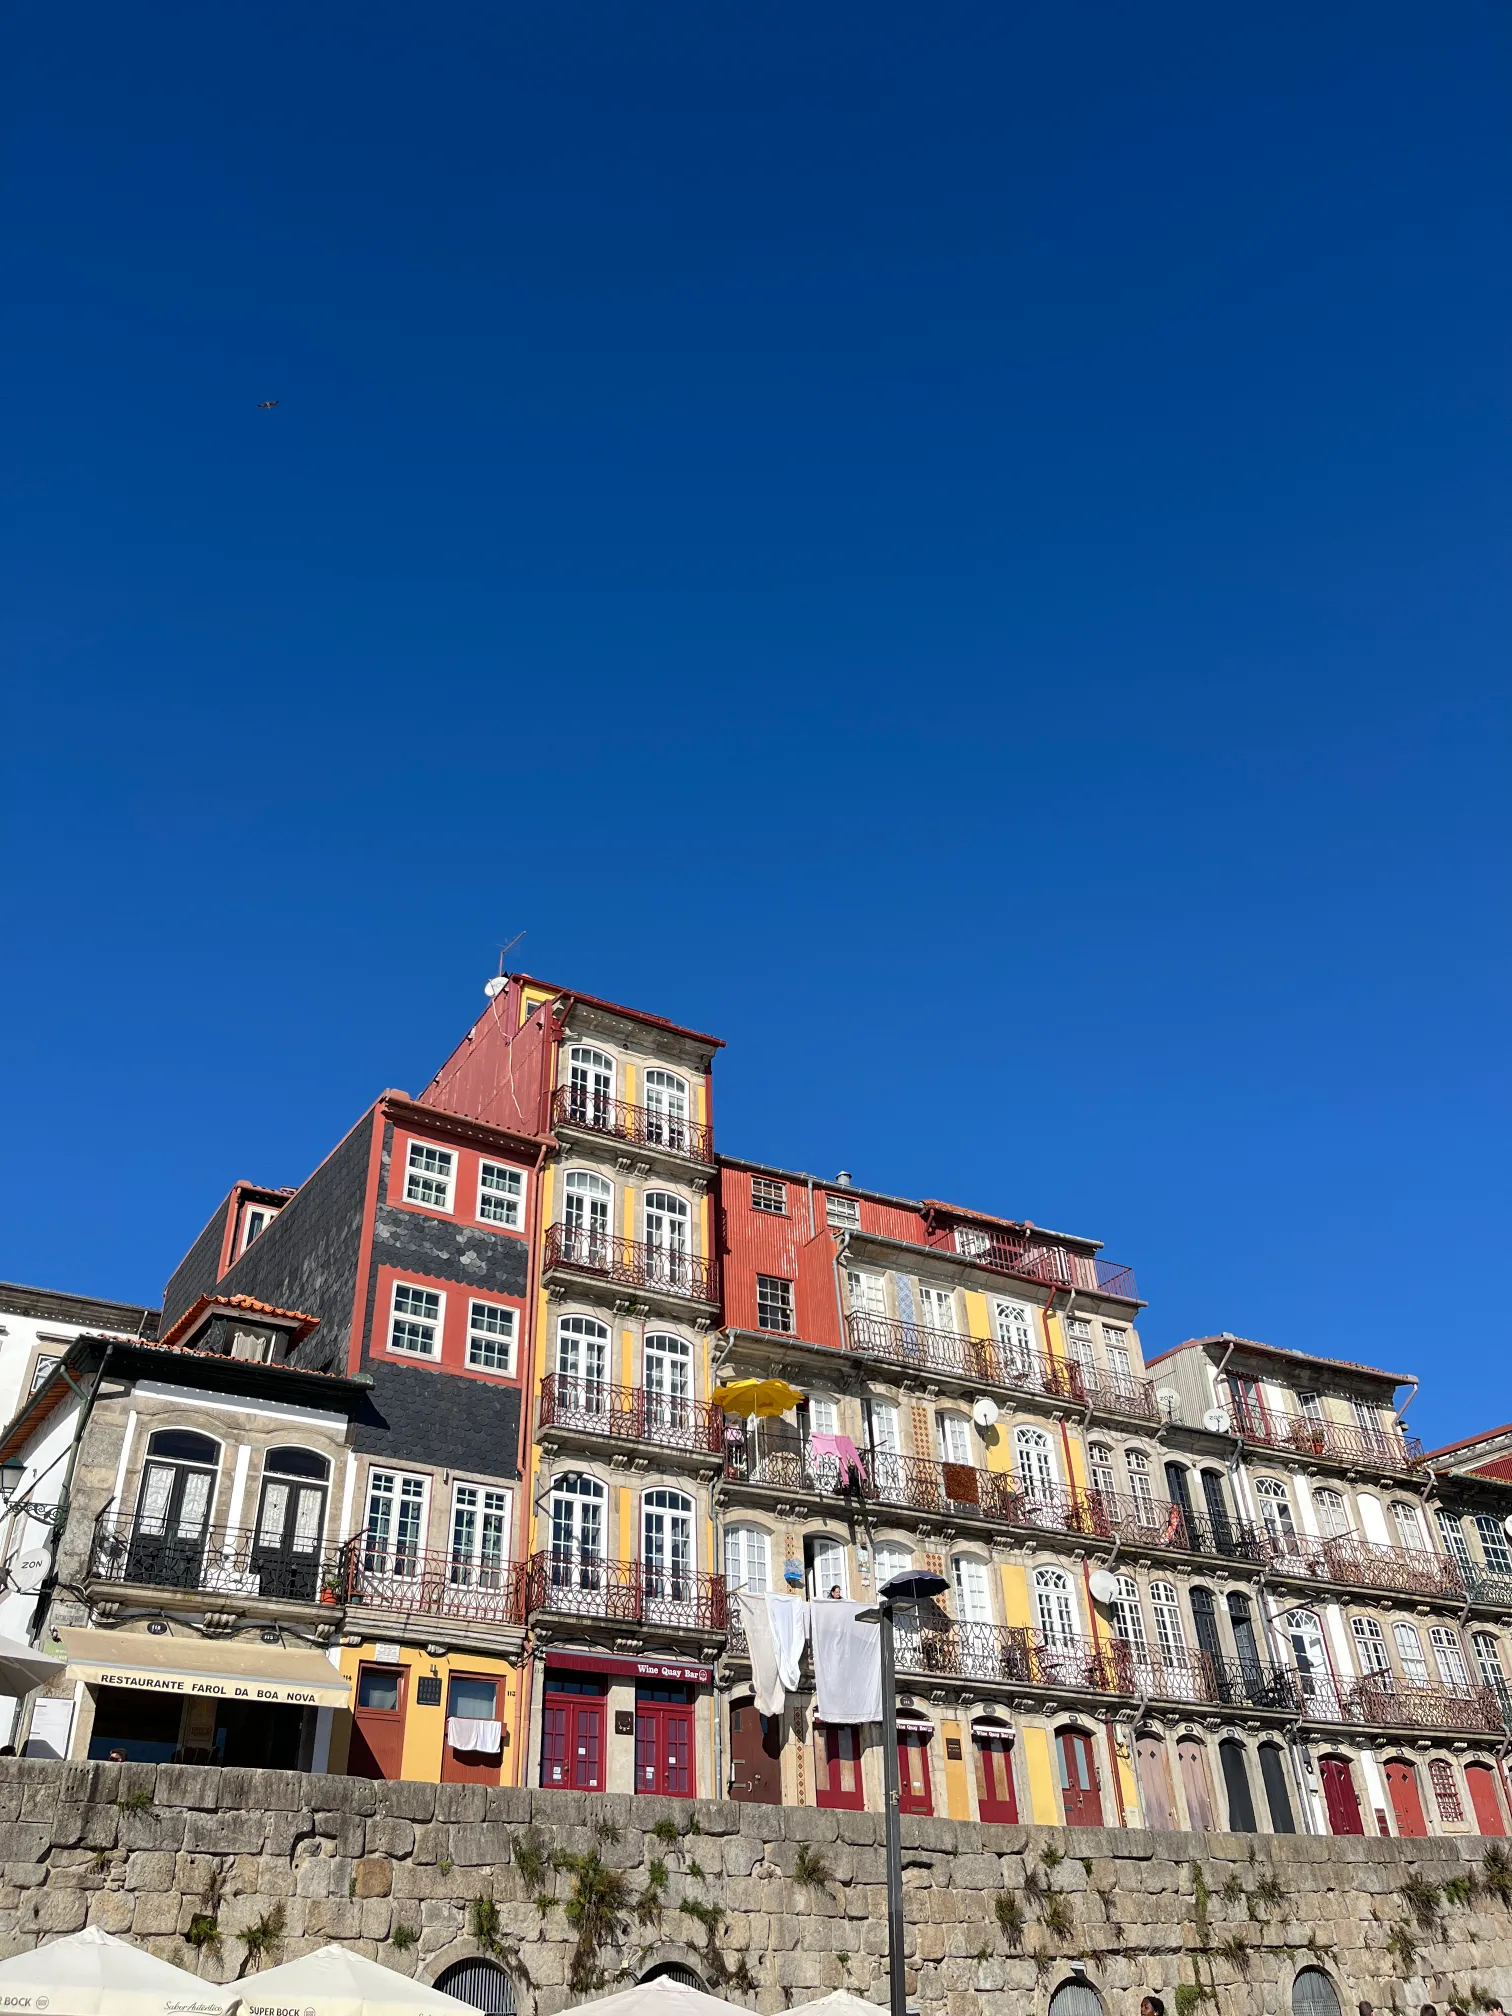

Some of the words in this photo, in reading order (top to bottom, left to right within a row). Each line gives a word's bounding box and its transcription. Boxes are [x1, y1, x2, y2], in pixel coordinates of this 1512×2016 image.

[21, 1560, 43, 1569] ZON
[637, 1664, 659, 1674] Wine
[661, 1667, 682, 1678] Quay
[684, 1669, 699, 1679] Bar
[101, 1674, 184, 1690] RESTAURANTE
[191, 1683, 227, 1695] FAROL
[234, 1687, 249, 1697] DA
[256, 1689, 279, 1700] BOA
[286, 1692, 316, 1703] NOVA
[4, 1996, 32, 2007] BOCK
[163, 2000, 187, 2011] Sabor
[249, 2005, 275, 2016] SUPER
[276, 2008, 301, 2016] BOCK
